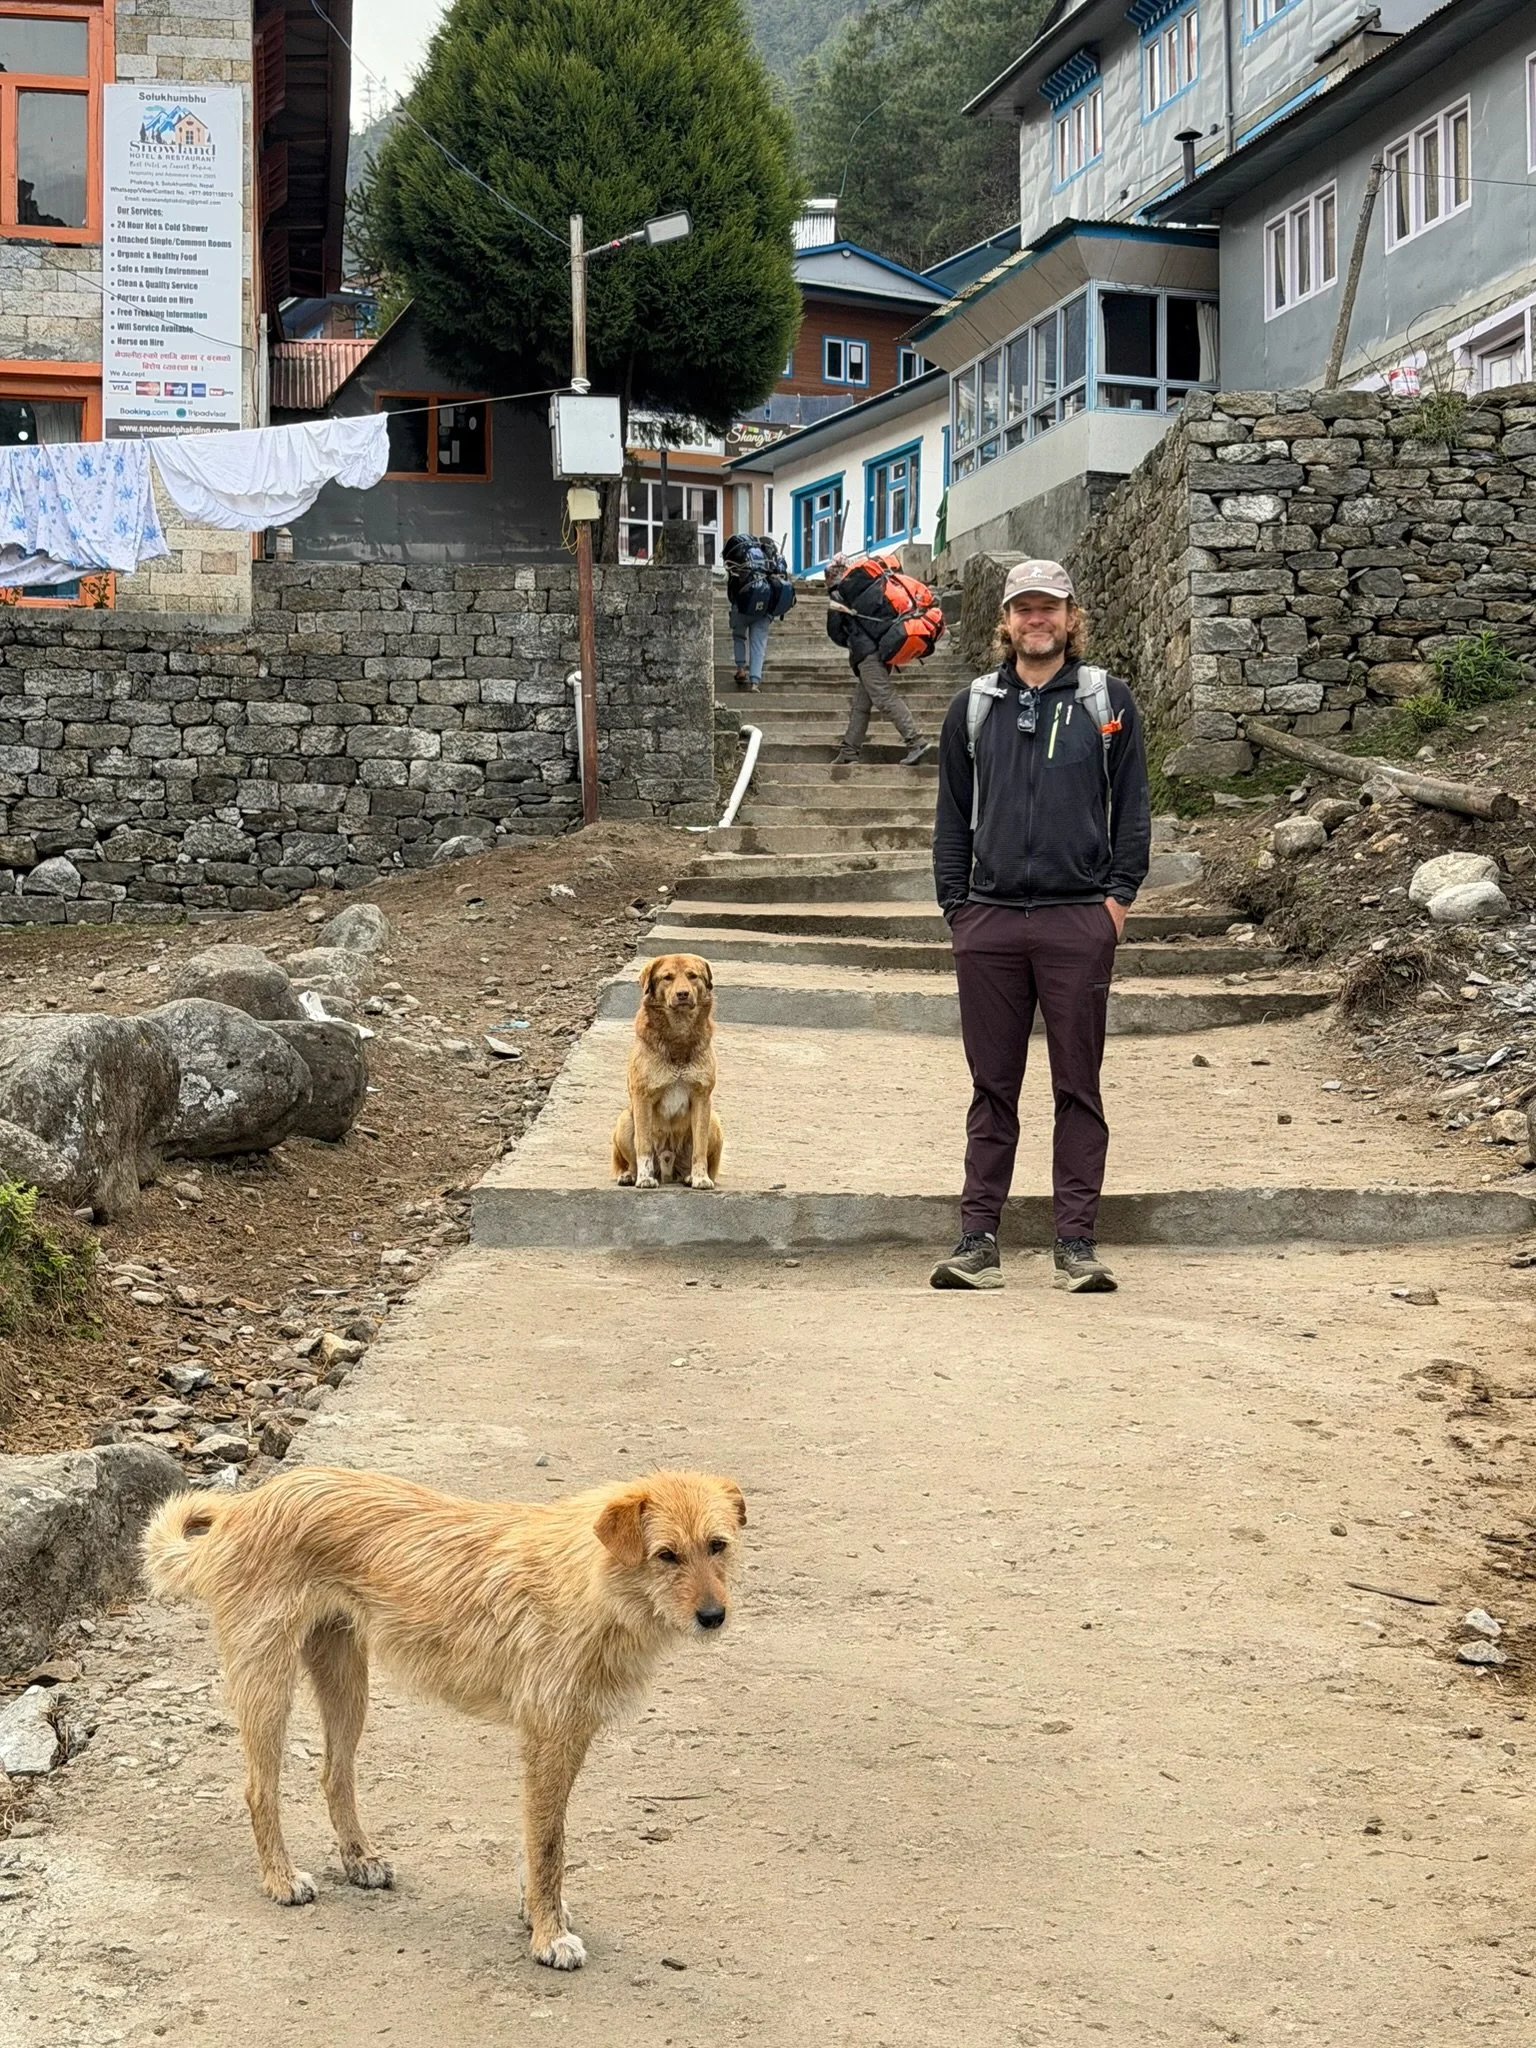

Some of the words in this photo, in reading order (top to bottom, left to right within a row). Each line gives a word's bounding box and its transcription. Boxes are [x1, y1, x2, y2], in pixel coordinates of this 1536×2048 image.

[138, 92, 207, 103] Solukhumbhu
[129, 139, 216, 156] Snowland
[129, 152, 155, 160] HOTEL
[165, 154, 216, 162] RESTAURANT
[117, 221, 126, 229] 24
[127, 221, 144, 230] Hour
[145, 222, 157, 230] Hot
[164, 222, 181, 232] Cold
[182, 223, 208, 233] Shower
[117, 235, 149, 244] Attached
[150, 236, 207, 247] Single/Common
[207, 239, 232, 248] Rooms
[117, 250, 145, 259] Organic
[152, 251, 179, 261] Healthy
[180, 252, 197, 261] Food
[117, 264, 133, 273] Safe
[140, 265, 164, 275] Family
[164, 266, 209, 276] Environment
[117, 279, 138, 288] Clean
[145, 280, 170, 290] Quality
[171, 281, 198, 290] Service
[117, 293, 139, 302] Porter
[146, 294, 168, 304] Guide
[179, 295, 194, 304] Hire
[117, 308, 133, 317] Free
[134, 308, 165, 319] Trekking
[166, 310, 208, 320] Information
[117, 322, 132, 331] Wifi
[133, 323, 159, 333] Service
[160, 324, 194, 333] Available
[117, 337, 138, 346] Horse
[149, 338, 164, 347] Hire
[122, 371, 145, 379] Accept
[120, 408, 169, 417] Booking.com
[188, 409, 227, 418] Tripadvisor
